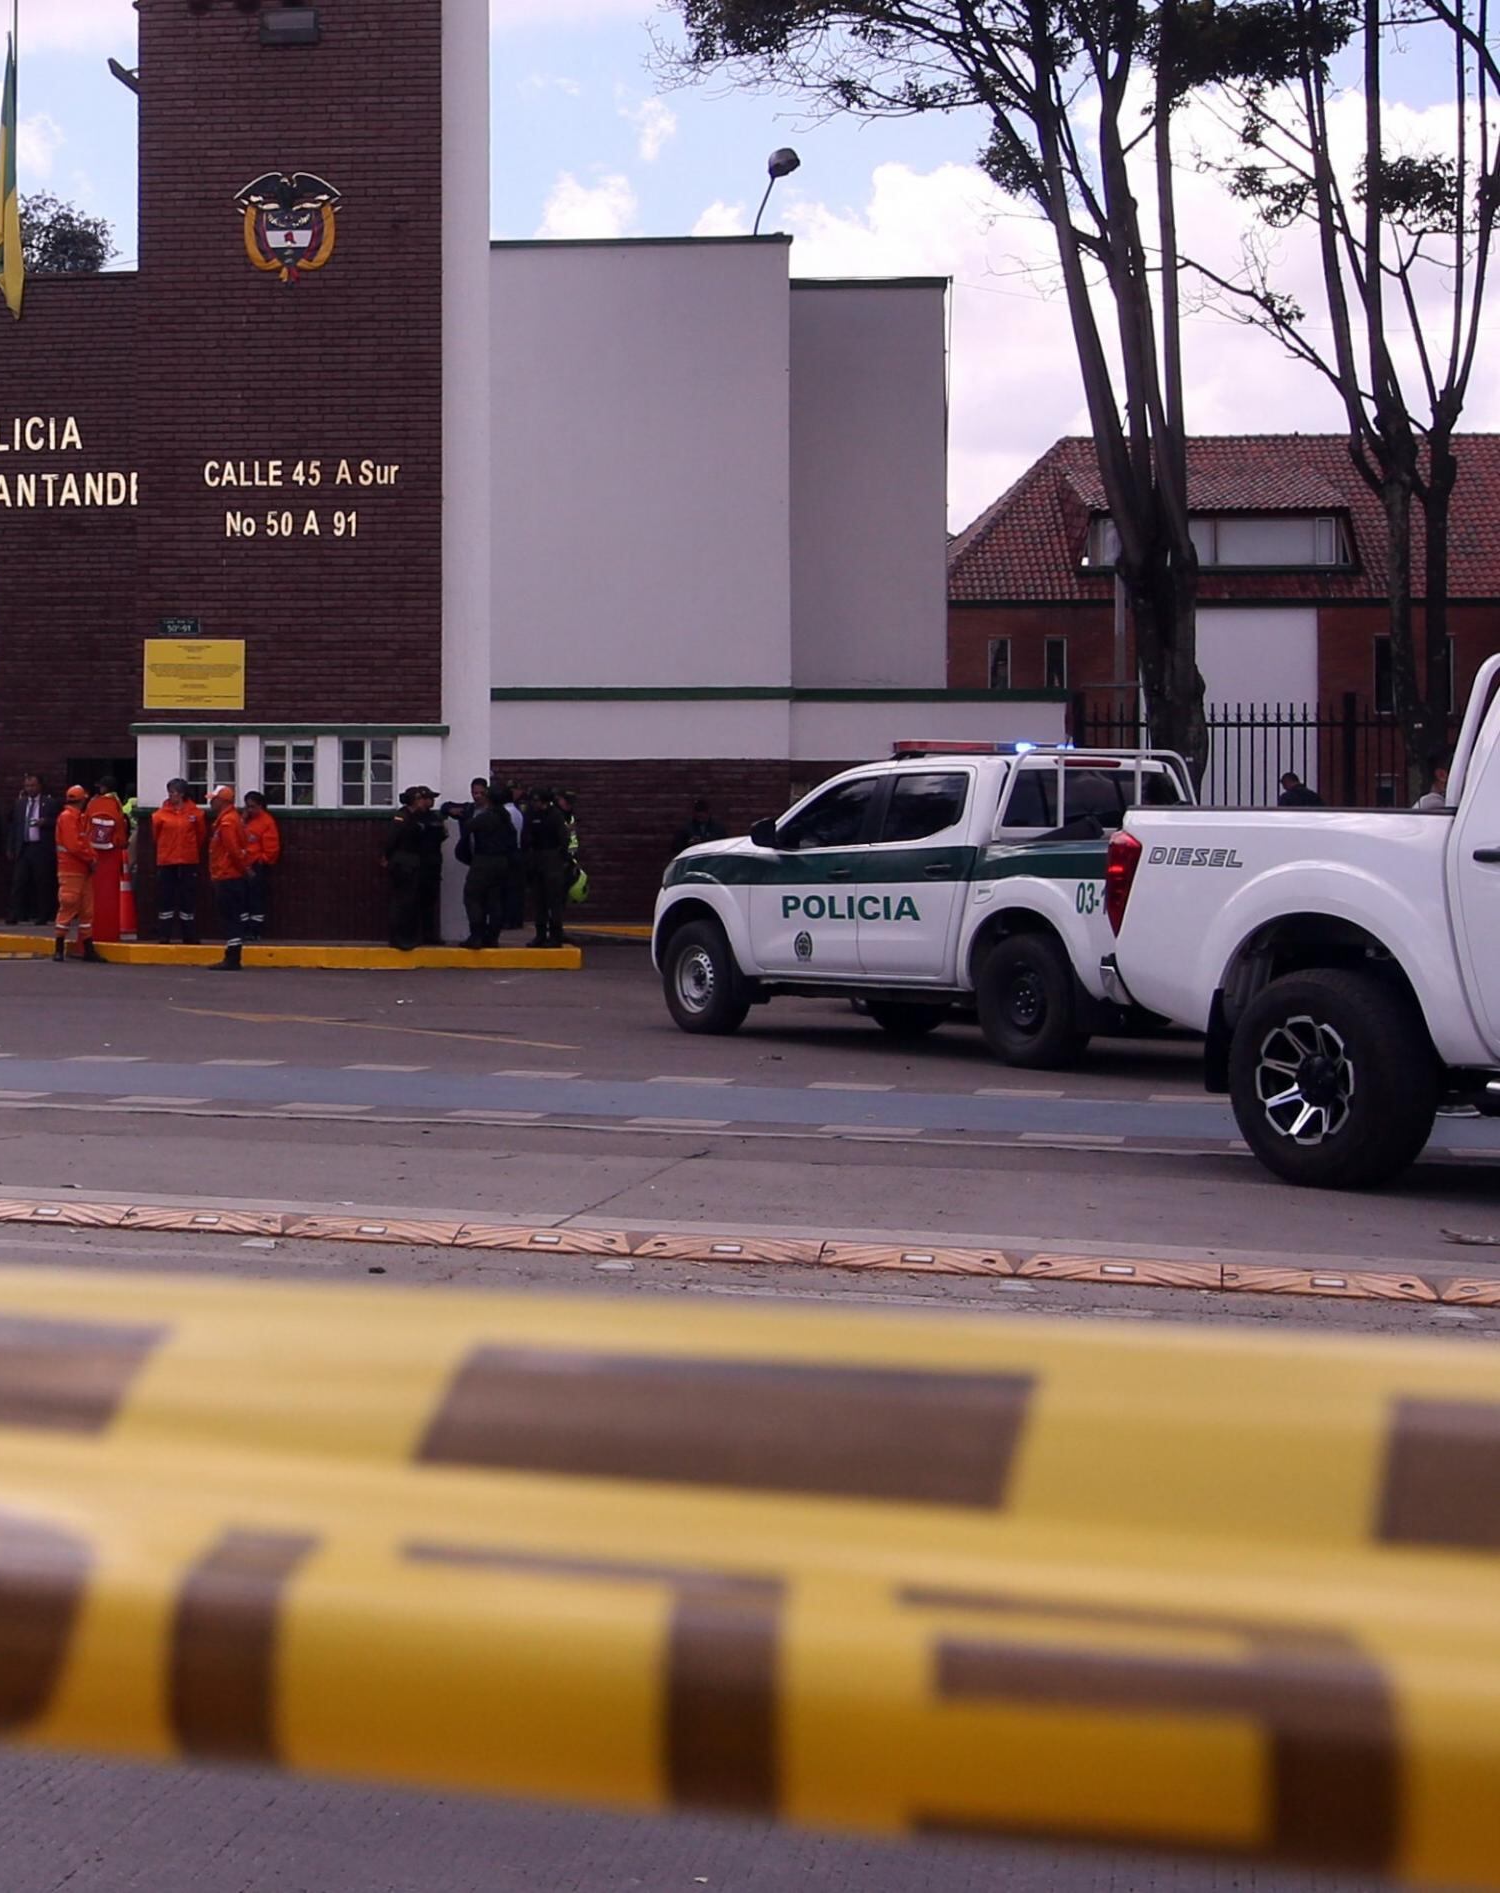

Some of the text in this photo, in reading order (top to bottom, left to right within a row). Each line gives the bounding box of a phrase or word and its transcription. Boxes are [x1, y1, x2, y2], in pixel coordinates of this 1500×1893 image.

[204, 459, 399, 487] CALLE 45 A Sur
[226, 510, 357, 537] No 50 A 91
[1149, 846, 1244, 868] DIESEL
[781, 895, 921, 921] POLICIA
